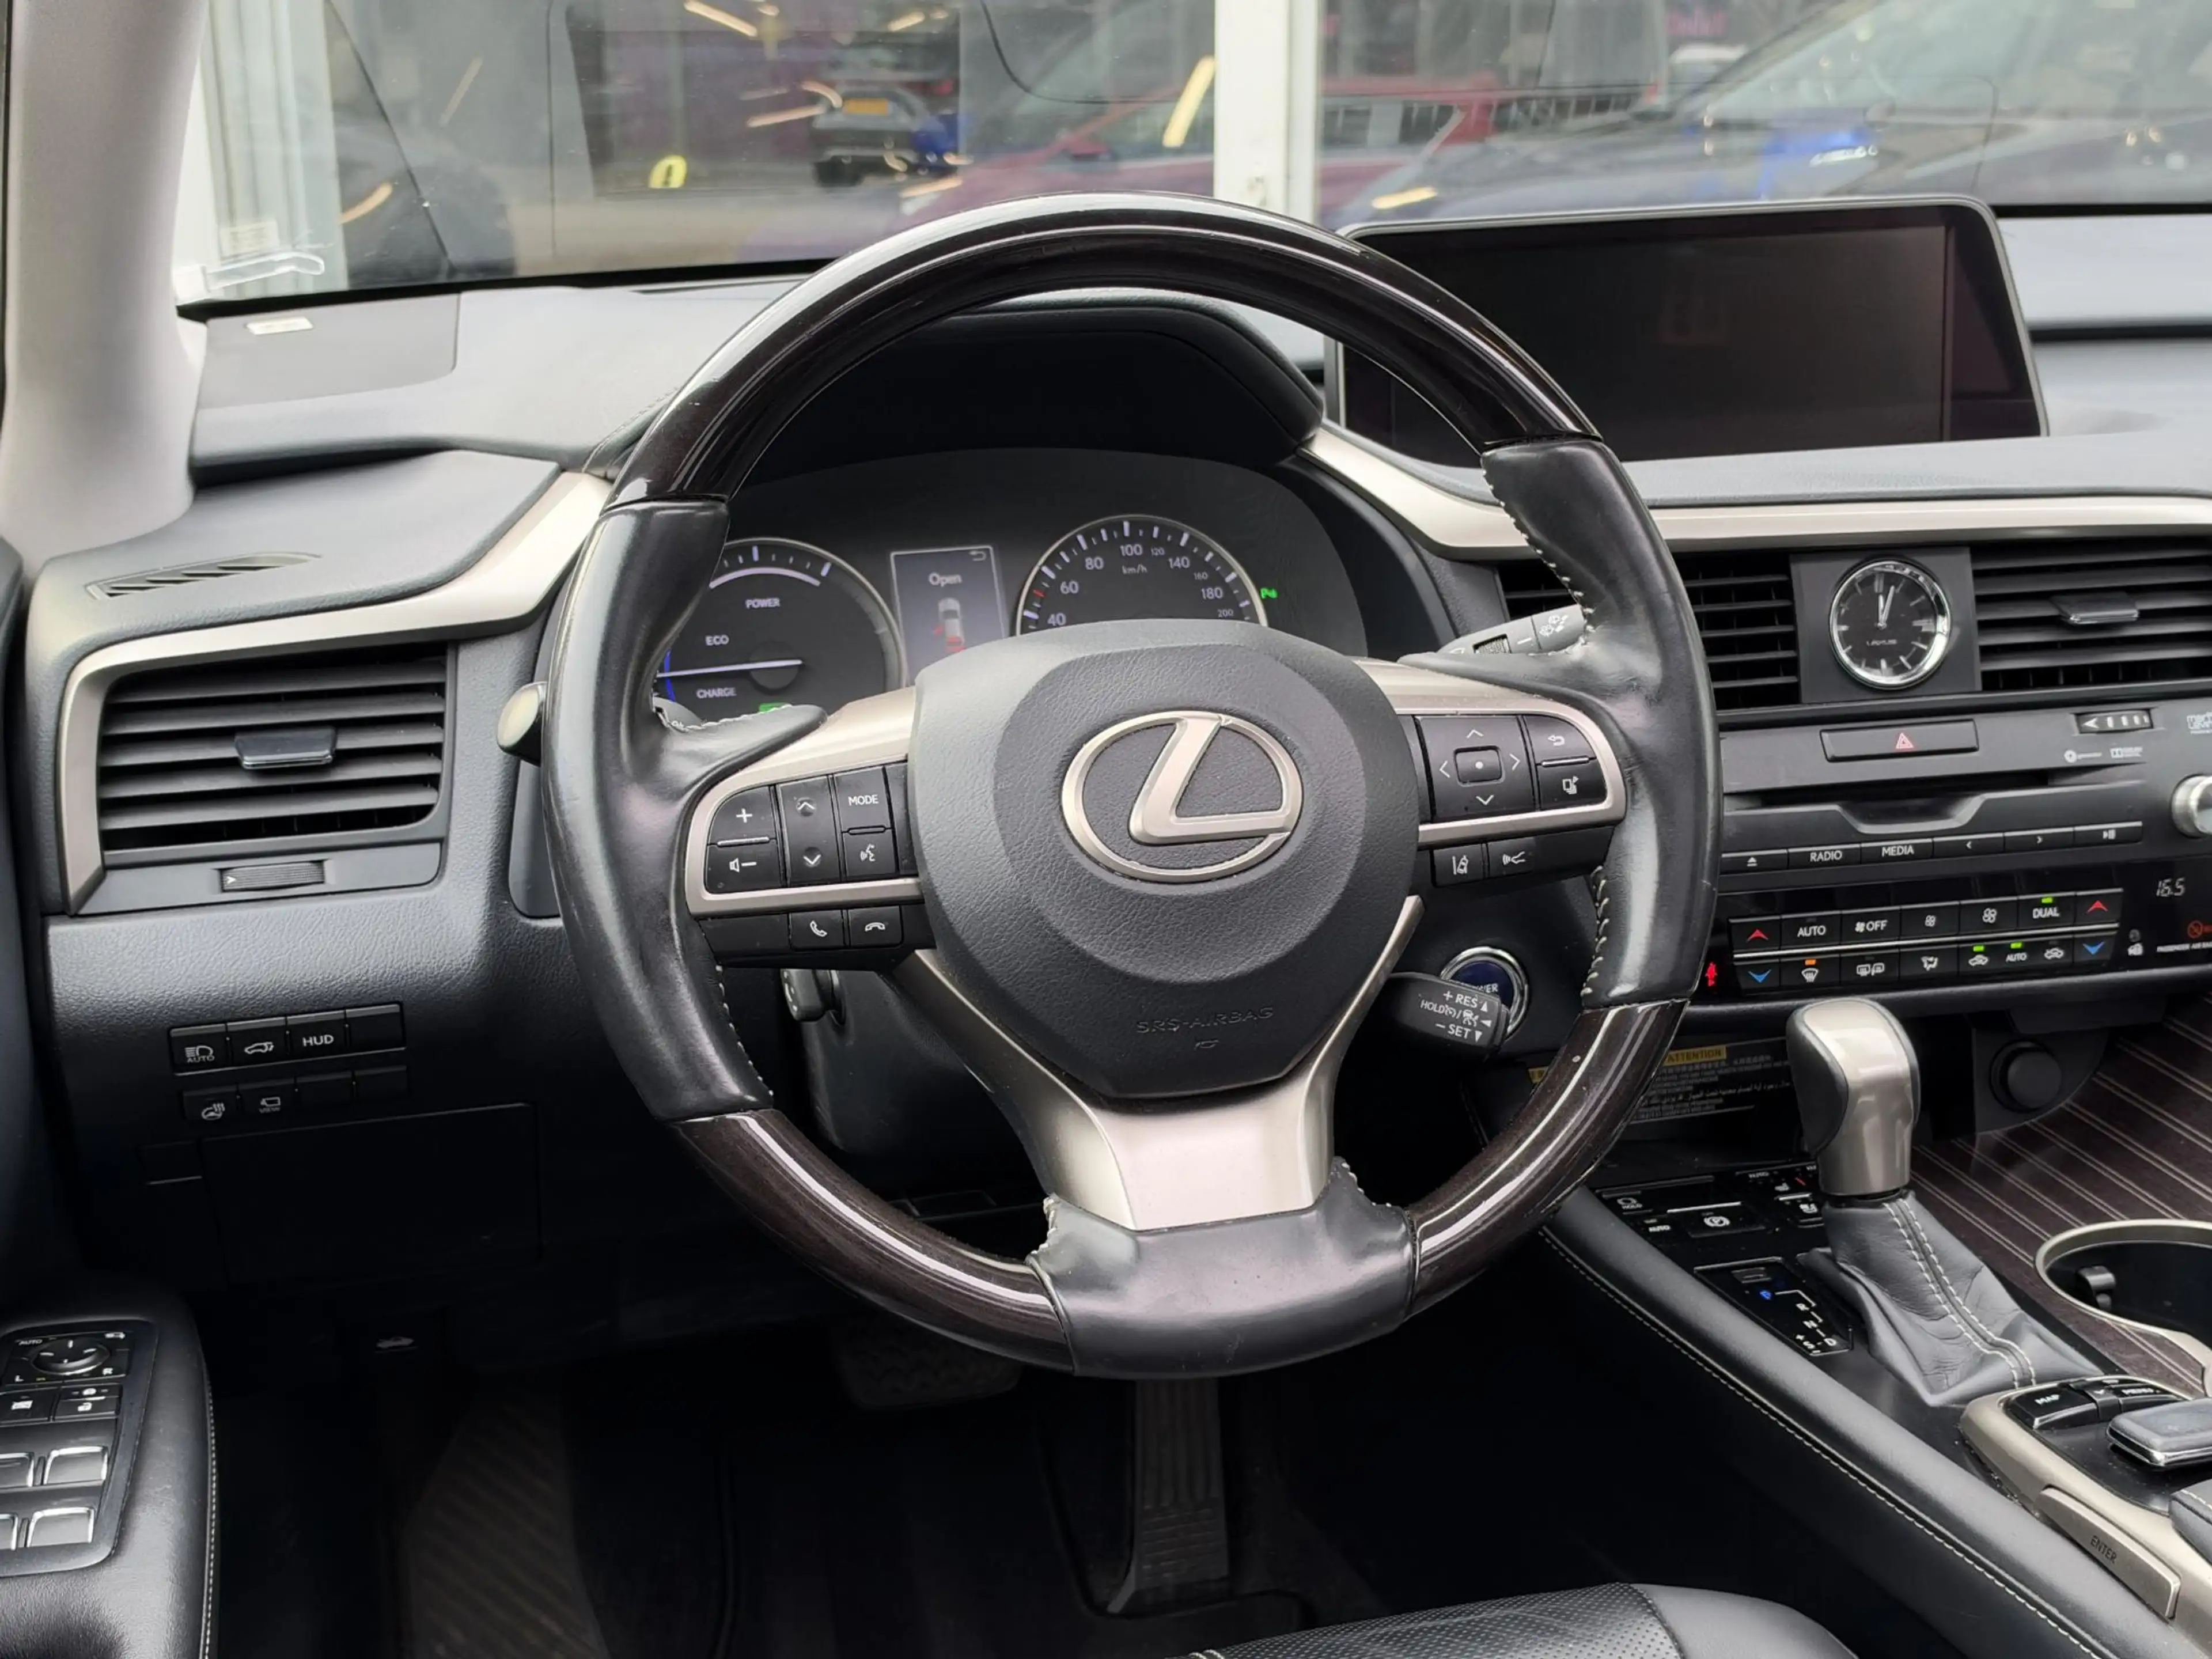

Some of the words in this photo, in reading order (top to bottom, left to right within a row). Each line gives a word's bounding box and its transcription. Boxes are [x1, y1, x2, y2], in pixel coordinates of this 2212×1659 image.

[1120, 544, 1143, 556] 100
[1085, 556, 1104, 570] 80
[1169, 556, 1191, 569] 140
[1122, 563, 1148, 575] km/h
[929, 571, 963, 587] Open
[1060, 581, 1080, 594] 60
[1201, 587, 1224, 599] 180
[745, 597, 781, 608] POWER
[1047, 613, 1066, 626] 40
[1218, 609, 1234, 618] 200
[705, 634, 729, 646] ECO
[696, 687, 737, 699] CHARGE
[848, 794, 880, 806] MODE
[1810, 850, 1843, 863] RADIO
[1881, 844, 1915, 857] MEDIA
[2032, 907, 2060, 919] DUAL
[1866, 919, 1888, 931] OFF
[1797, 925, 1827, 938] AUTO
[2006, 952, 2027, 963] AUTO
[1420, 999, 1445, 1014] HOLD
[1455, 994, 1478, 1009] RES
[1448, 1024, 1472, 1040] SET
[302, 1035, 335, 1047] HUD
[186, 1055, 215, 1063] AUTO
[1667, 1048, 1722, 1063] ATTENTION
[2090, 1535, 2117, 1565] ENTER
